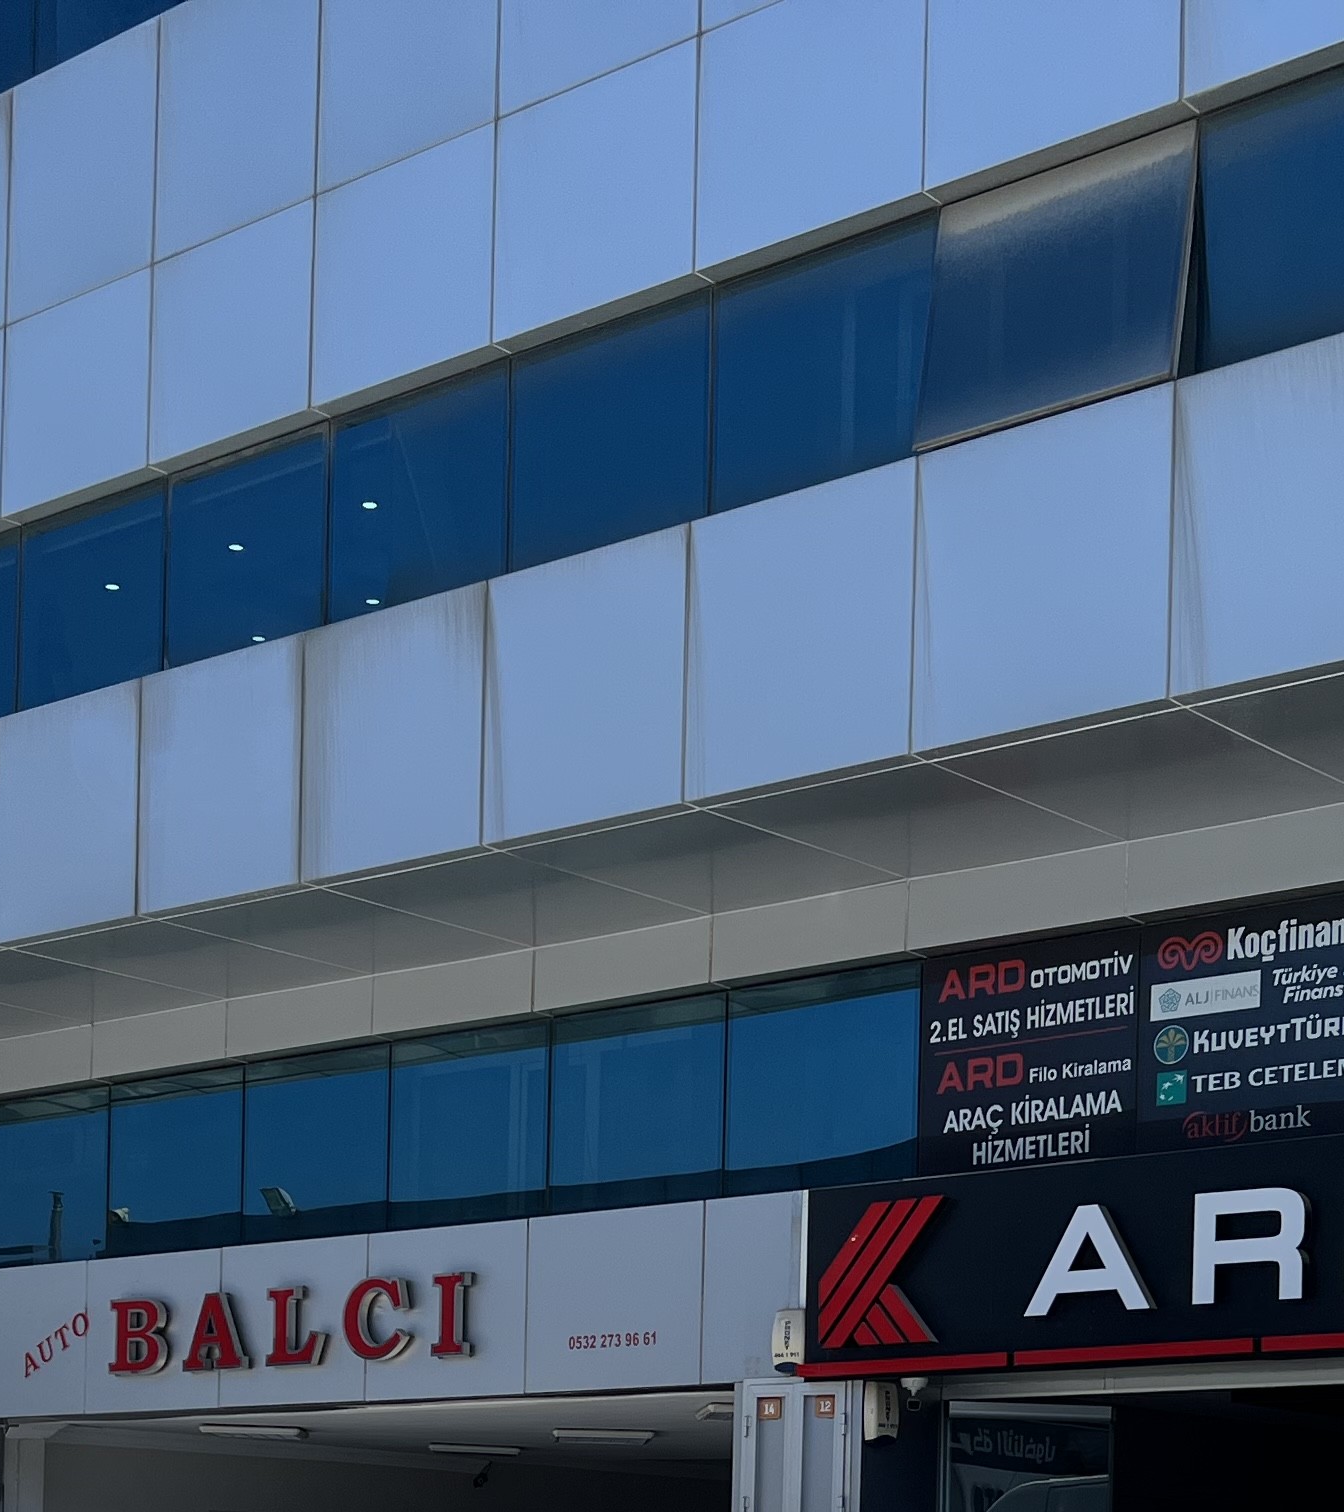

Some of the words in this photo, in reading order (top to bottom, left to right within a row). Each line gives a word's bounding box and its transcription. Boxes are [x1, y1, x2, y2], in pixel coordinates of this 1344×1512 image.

[939, 959, 1025, 1004] ARD
[1031, 950, 1133, 989] OTOMOTİV
[1272, 964, 1338, 986] Türkiye
[1283, 984, 1344, 1003] Finans
[930, 1018, 967, 1043] 2.EL
[973, 1009, 1020, 1038] SATIŞ
[1027, 986, 1134, 1030] HİZMETLERİ
[937, 1052, 1024, 1094] ARD
[1030, 1066, 1057, 1083] Filo
[1062, 1058, 1132, 1079] Kiralama
[1192, 1072, 1240, 1092] TEB
[943, 1104, 1004, 1135] ARAÇ
[1011, 1090, 1122, 1126] KİRALAMA
[1187, 1113, 1241, 1139] aktif
[1249, 1105, 1311, 1132] bank
[973, 1124, 1090, 1165] HİZMETLERİ
[24, 1312, 90, 1378] AUTO
[108, 1271, 476, 1376] BALCI
[568, 1334, 598, 1350] 0532
[600, 1332, 622, 1348] 273
[625, 1332, 640, 1348] 96
[764, 1404, 774, 1415] 14
[820, 1401, 832, 1412] 12
